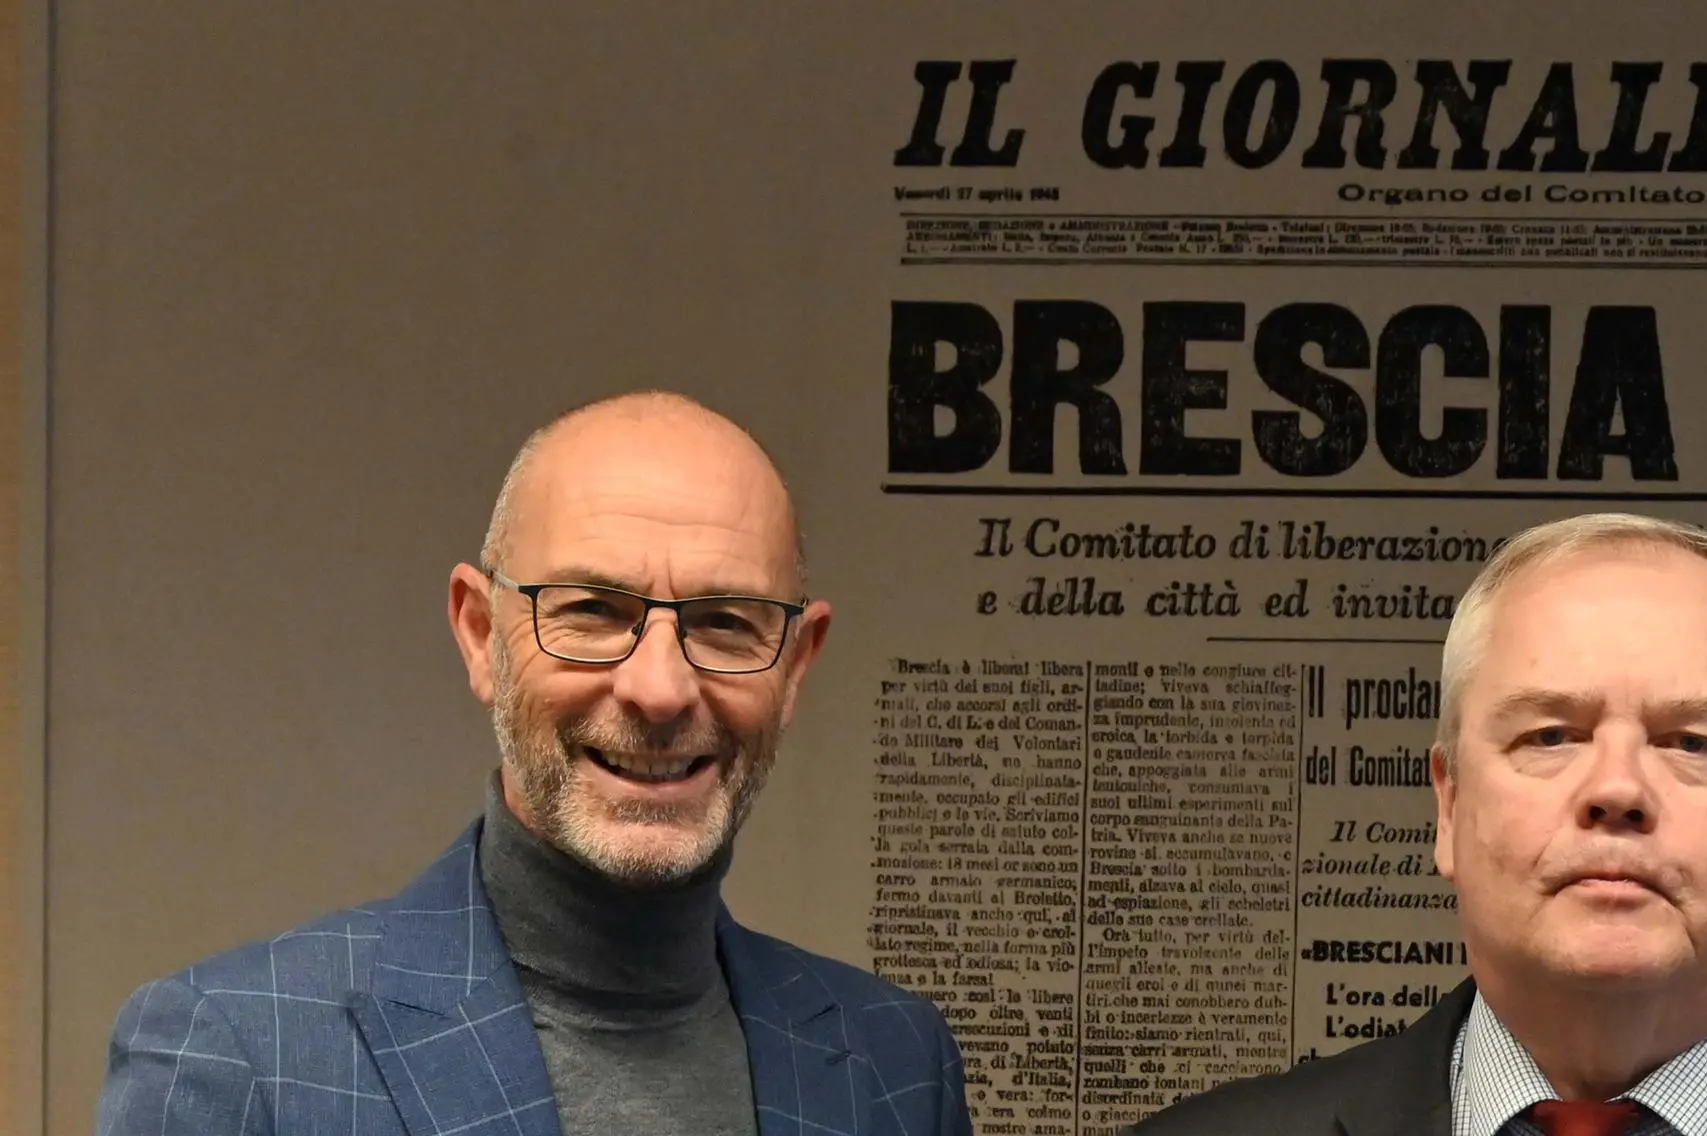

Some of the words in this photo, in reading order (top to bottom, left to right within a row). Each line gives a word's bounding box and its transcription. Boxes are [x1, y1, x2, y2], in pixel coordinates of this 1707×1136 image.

[893, 59, 1026, 167] IL
[1337, 183, 1469, 205] Organo
[1481, 185, 1532, 203] del
[1544, 185, 1705, 204] Comitato
[886, 300, 1677, 482] BRESCIA
[975, 518, 1014, 557] Il
[1024, 518, 1218, 560] Comitato
[1229, 521, 1270, 560] di
[977, 590, 998, 616] e
[1020, 576, 1125, 617] della
[1146, 580, 1241, 618] città
[1264, 580, 1309, 619] ed
[1333, 582, 1456, 620] invita
[1041, 661, 1084, 677] libera
[880, 681, 907, 697] per
[913, 680, 951, 694] virtù
[982, 681, 1014, 695] suoi
[1162, 682, 1210, 695] viveva
[1308, 665, 1325, 718] Il
[1344, 666, 1441, 730] procla
[1013, 735, 1082, 751] Volontari
[1306, 745, 1337, 786] del
[1350, 744, 1433, 787] Comitat
[1090, 813, 1131, 829] corpo
[1330, 821, 1356, 843] Il
[1127, 829, 1177, 844] Viveva
[1301, 852, 1391, 877] zionale
[1397, 853, 1423, 877] di
[1159, 916, 1188, 927] case
[1326, 982, 1386, 1007] L'ora
[1326, 1015, 1407, 1039] L'odiat
